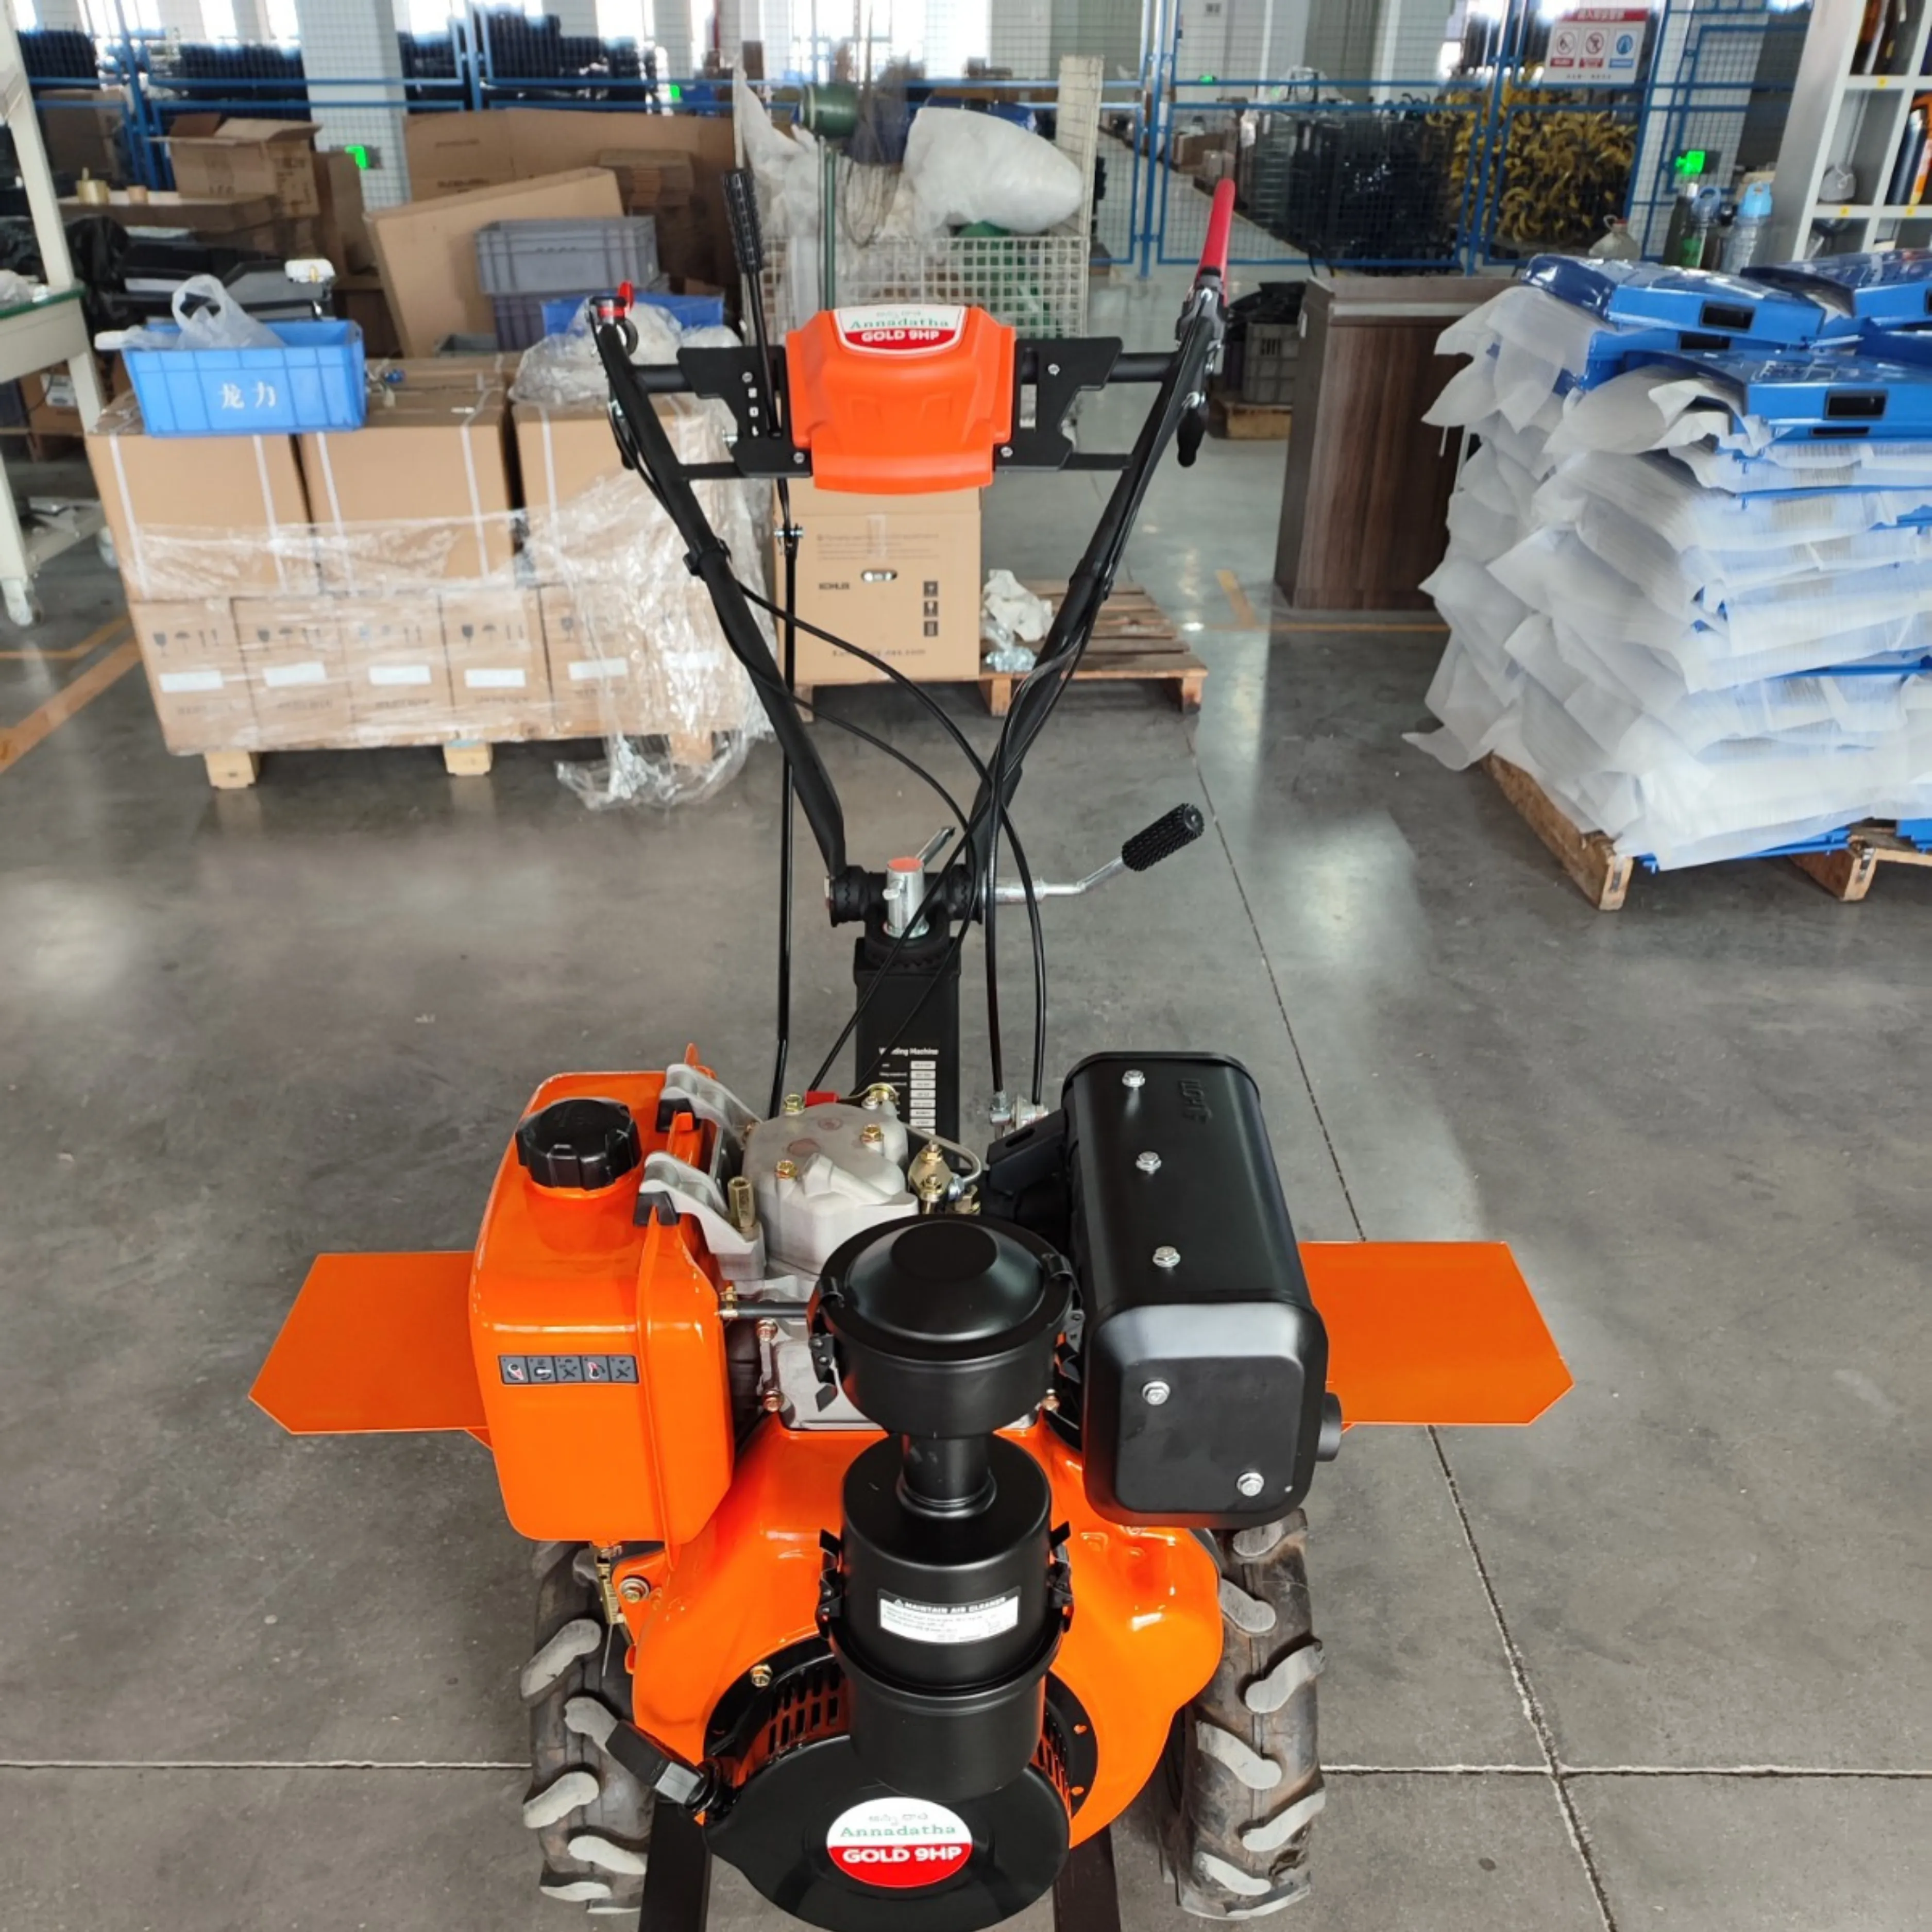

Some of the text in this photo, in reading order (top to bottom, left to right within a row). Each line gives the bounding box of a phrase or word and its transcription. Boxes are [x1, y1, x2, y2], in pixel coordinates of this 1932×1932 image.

[851, 318, 949, 329] Annadatha
[861, 329, 940, 342] GOLD 9HP
[218, 381, 276, 409] 龙力
[840, 1824, 956, 1838] Annadatha
[842, 1846, 962, 1863] GOLD 9HP
